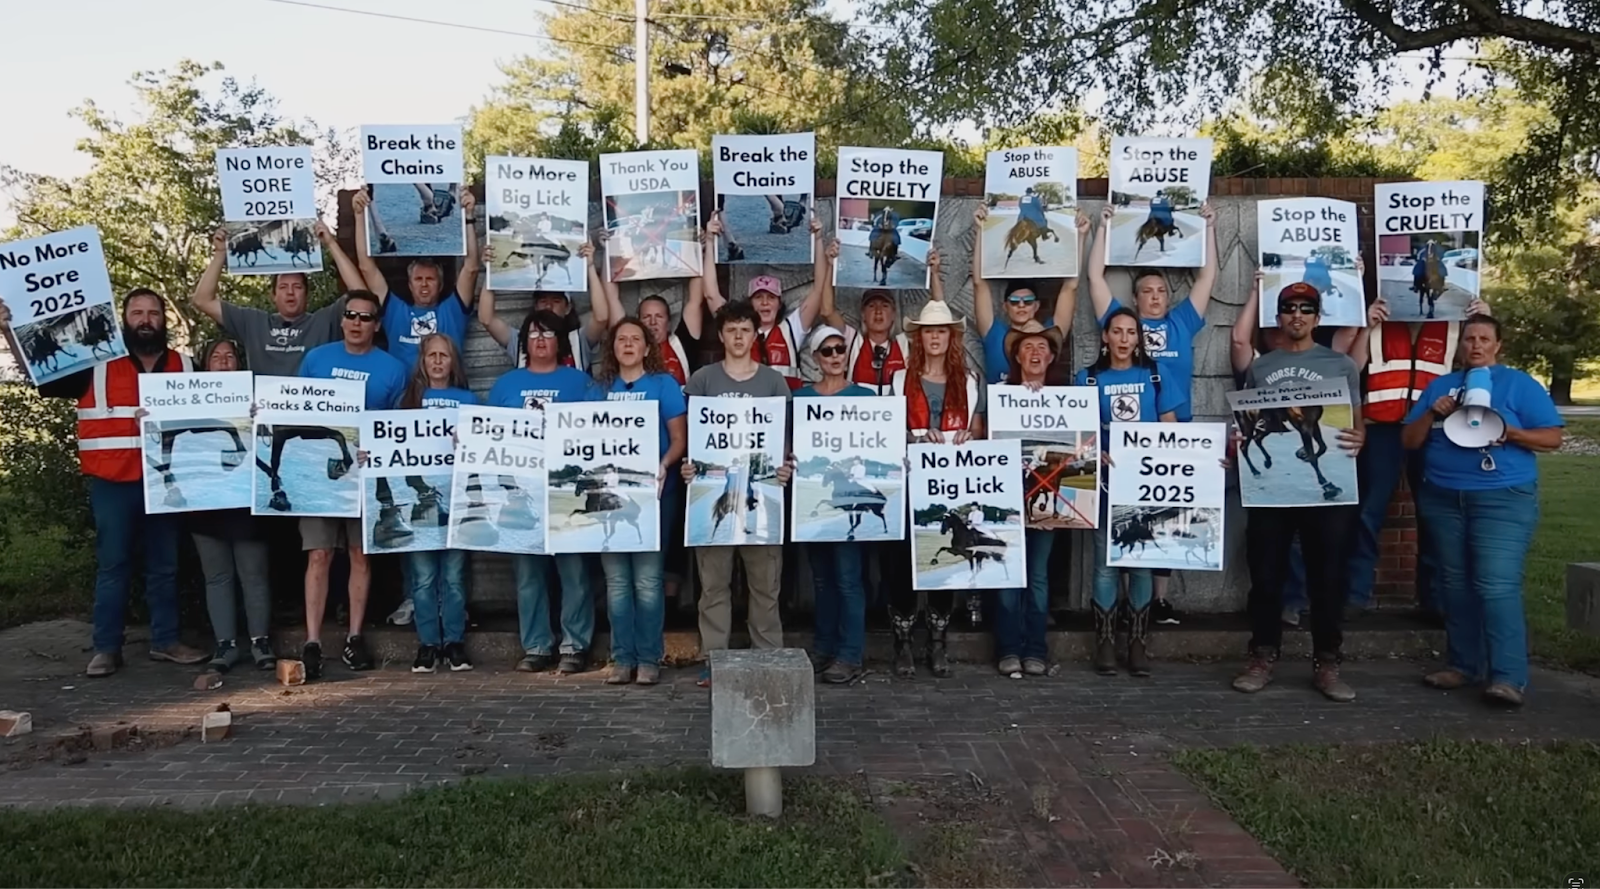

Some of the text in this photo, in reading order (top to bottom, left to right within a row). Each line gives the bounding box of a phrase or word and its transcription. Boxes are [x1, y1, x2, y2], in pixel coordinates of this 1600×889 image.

[367, 134, 456, 150] Break the
[720, 146, 808, 162] Break the
[1004, 150, 1054, 164] Stop the
[1122, 145, 1197, 164] Stop the
[226, 155, 304, 171] No More
[381, 160, 444, 175] Chains
[610, 158, 688, 174] Thank You
[851, 158, 928, 178] Stop the
[498, 164, 577, 182] No More
[733, 172, 795, 186] Chains
[1009, 166, 1050, 178] ABUSE
[1128, 168, 1189, 182] ABUSE
[242, 178, 292, 193] SORE
[629, 178, 671, 191] USDA
[846, 180, 931, 198] CRUELTY
[502, 189, 571, 208] Big Lick
[1389, 190, 1470, 211] Stop the
[244, 200, 294, 216] 2025!
[1272, 206, 1346, 223] Stop the
[1385, 212, 1473, 232] CRUELTY
[1280, 227, 1342, 242] ABUSE
[0, 242, 89, 270] No More
[25, 270, 79, 292] Sore
[30, 290, 85, 317] 2025
[331, 367, 370, 381] BOYCOTT
[1265, 367, 1296, 385] HORSE
[166, 379, 222, 390] No More
[280, 384, 335, 396] No More
[1104, 383, 1145, 395] BOYCOTT
[1278, 385, 1312, 393] More
[144, 393, 250, 407] Stacks & Chains
[422, 398, 460, 408] BOYCOTT
[607, 391, 647, 400] BOYCOTT
[998, 394, 1088, 409] Thank You
[1237, 396, 1277, 405] Stacks
[1294, 390, 1342, 400] Chains!
[259, 399, 360, 413] Stacks & Chains
[807, 404, 892, 422] No More
[558, 411, 645, 429] No More
[700, 407, 773, 428] Stop the
[1020, 414, 1068, 428] USDA
[374, 418, 454, 443] Big Lick
[471, 417, 545, 441] Big Lic
[705, 432, 765, 449] ABUSE
[811, 430, 887, 452] Big Lick
[1123, 431, 1212, 449] No More
[461, 445, 476, 463] is
[563, 438, 640, 461] Big Lick
[367, 449, 454, 468] is Abuse
[921, 450, 1009, 469] No More
[1139, 457, 1195, 476] Sore
[928, 476, 1004, 500] Big Lick
[1138, 485, 1195, 503] 2025
